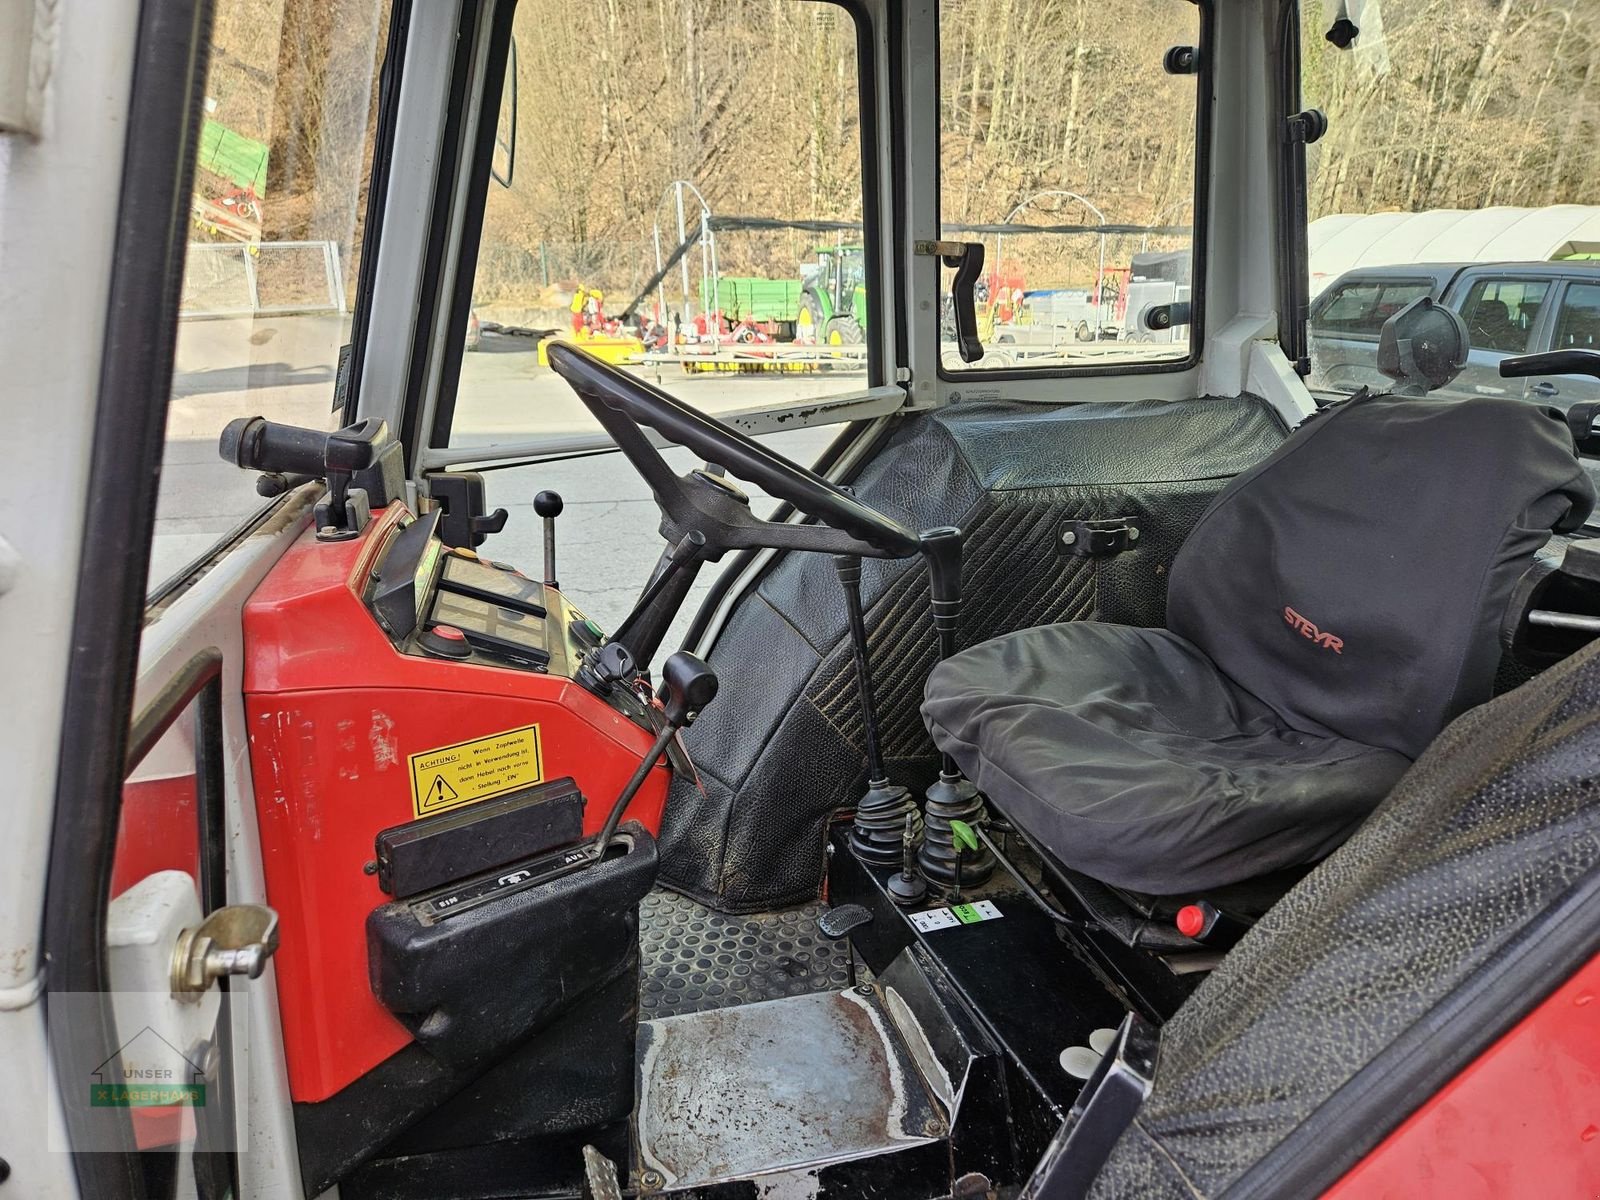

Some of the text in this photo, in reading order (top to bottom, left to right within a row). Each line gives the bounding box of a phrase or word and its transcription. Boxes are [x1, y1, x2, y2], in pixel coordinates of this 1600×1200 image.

[1283, 605, 1344, 655] STEYR
[473, 738, 525, 755] Wenn Zapfwelle
[458, 763, 473, 771] nicht
[484, 751, 520, 764] Verwendung
[459, 775, 475, 783] dann
[477, 769, 495, 778] Hebel
[477, 780, 501, 790] Stellung
